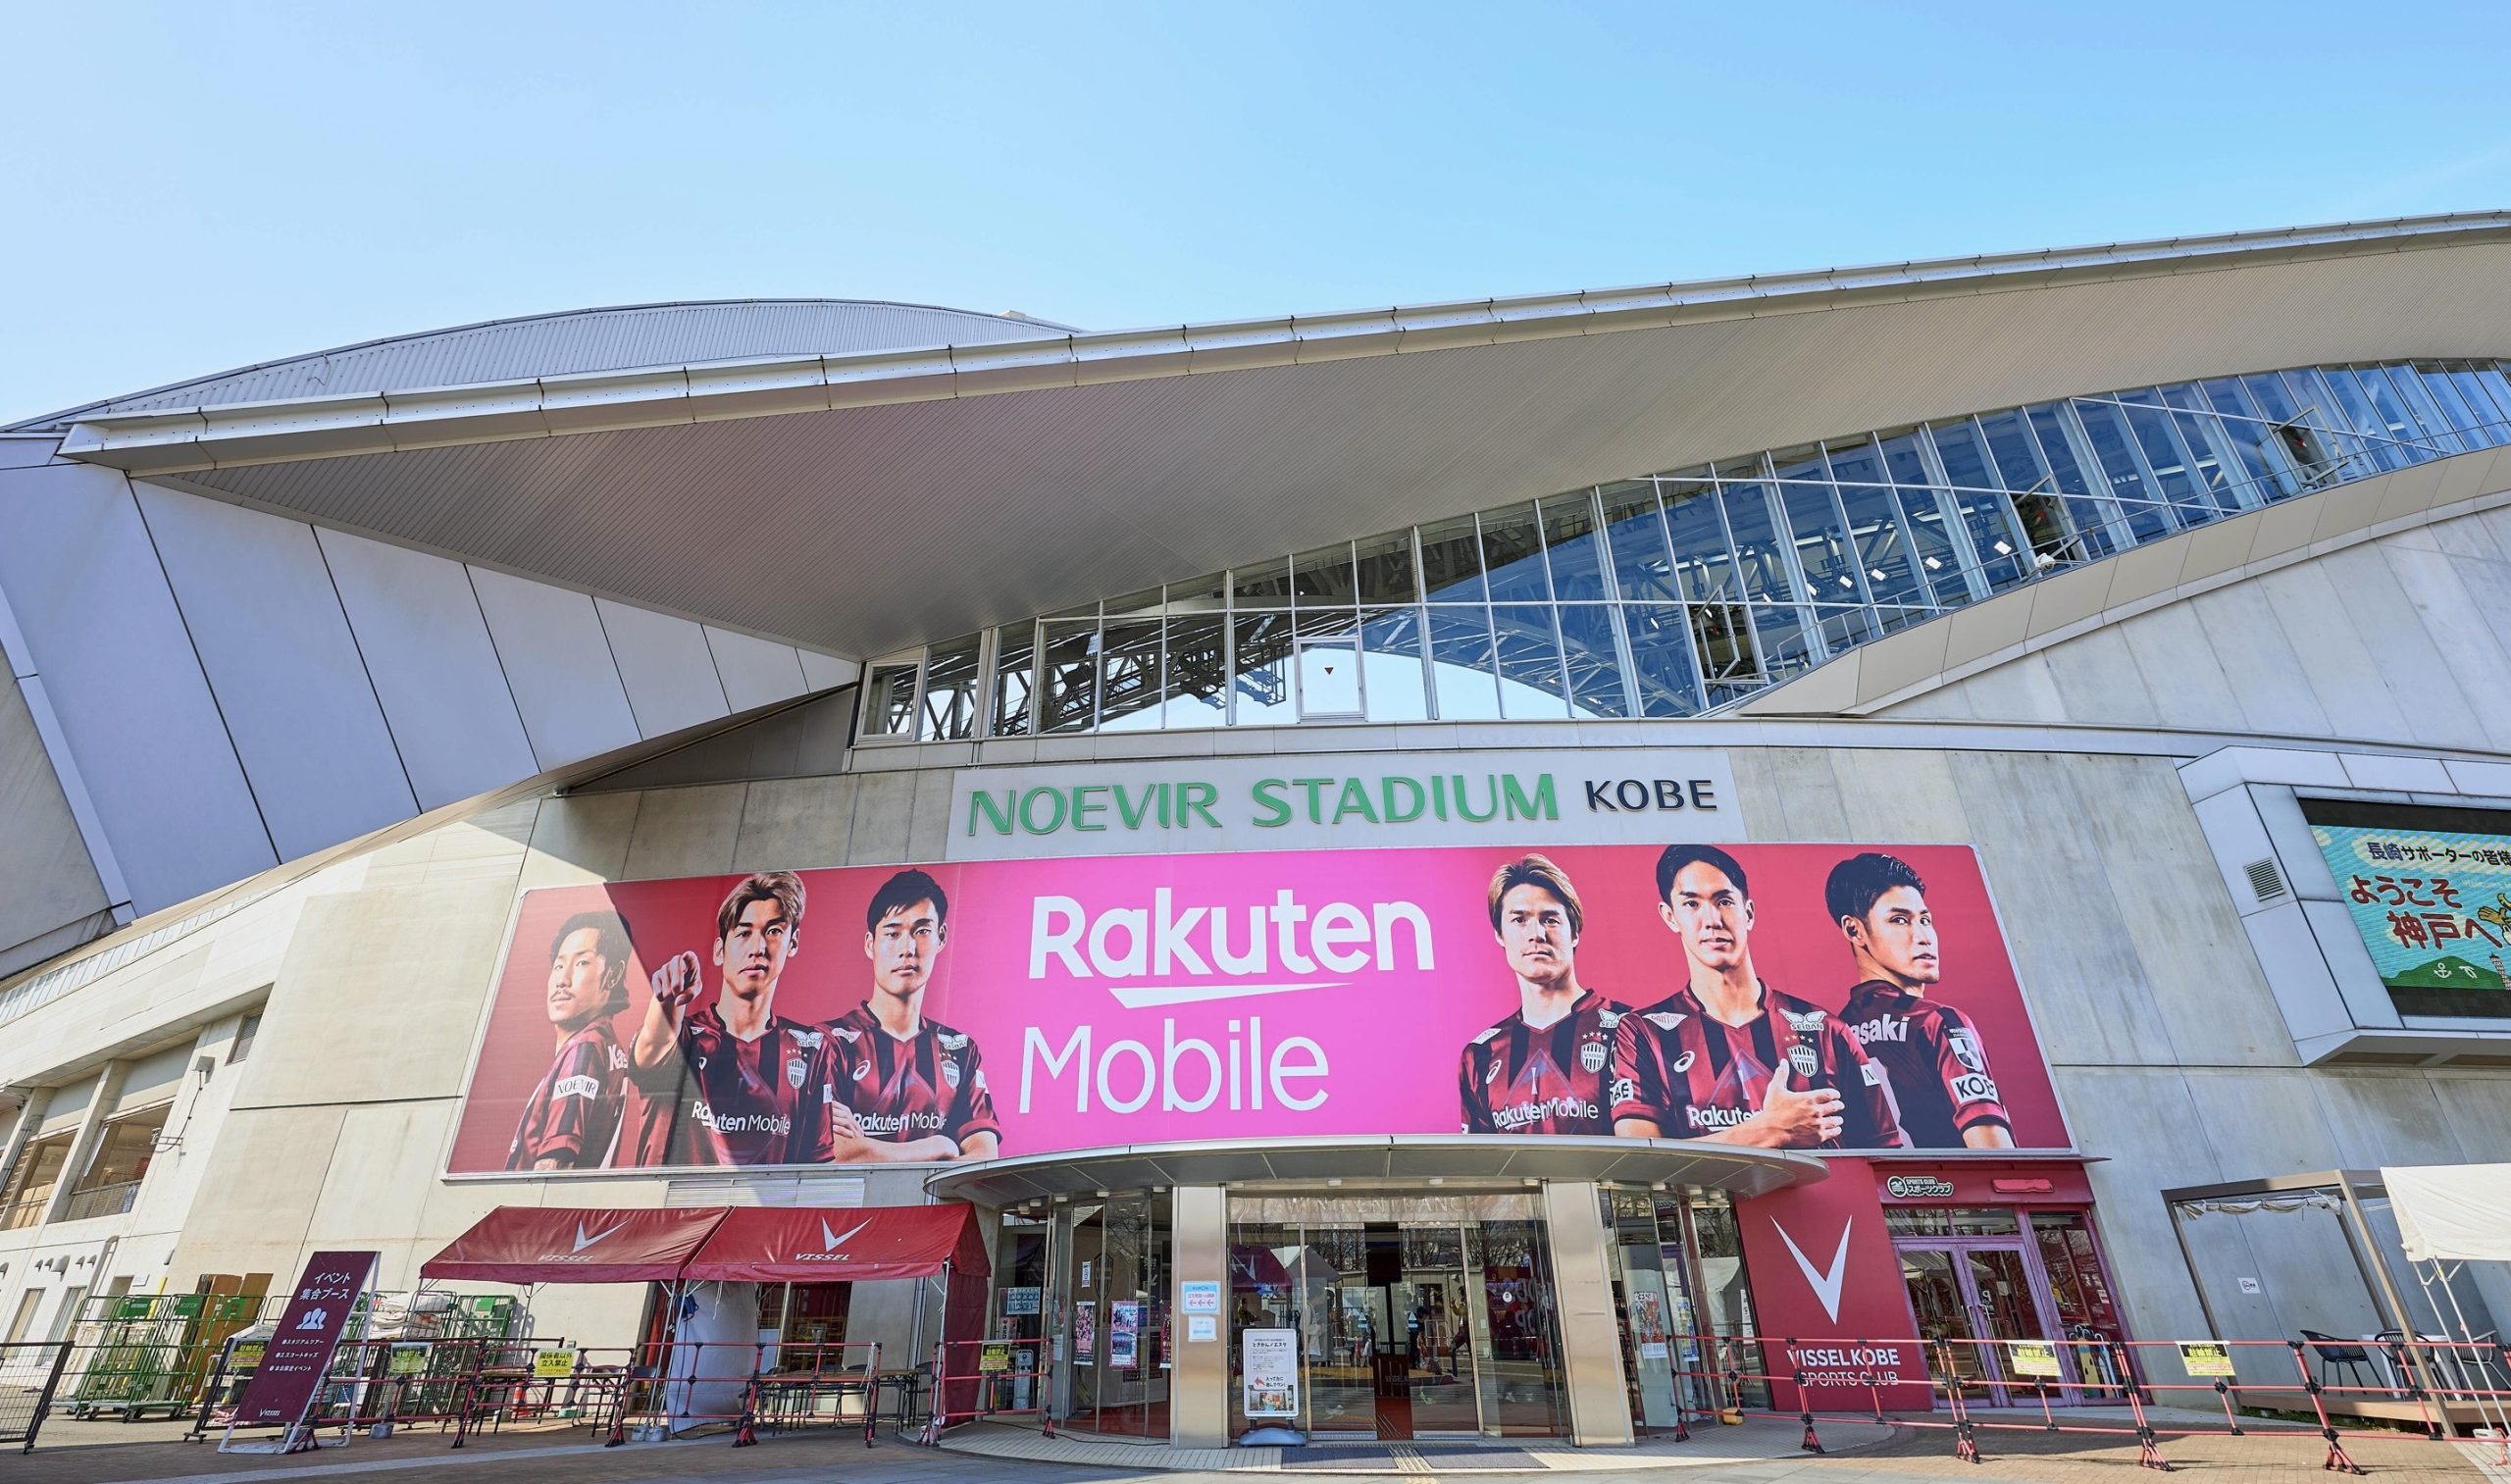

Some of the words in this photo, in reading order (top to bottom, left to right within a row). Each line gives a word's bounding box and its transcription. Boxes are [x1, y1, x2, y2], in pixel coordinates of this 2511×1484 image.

[967, 783, 1222, 837] NOEVIR
[1252, 773, 1560, 827] STADIUM
[1585, 779, 1718, 812] KOBE
[2351, 875, 2463, 908] ようこそ
[1028, 887, 1435, 980] Rakuten
[2386, 910, 2503, 949] 神戸へ
[1018, 1016, 1330, 1114] Mobile
[747, 1114, 791, 1135] Mobile
[1492, 1103, 1547, 1129] Rakuten
[1547, 1098, 1599, 1119] Mobile
[299, 1288, 350, 1301] 集合ブース
[315, 1272, 351, 1285] イベント
[1787, 1348, 1851, 1366] VISSEL
[1850, 1348, 1901, 1365] KOBE
